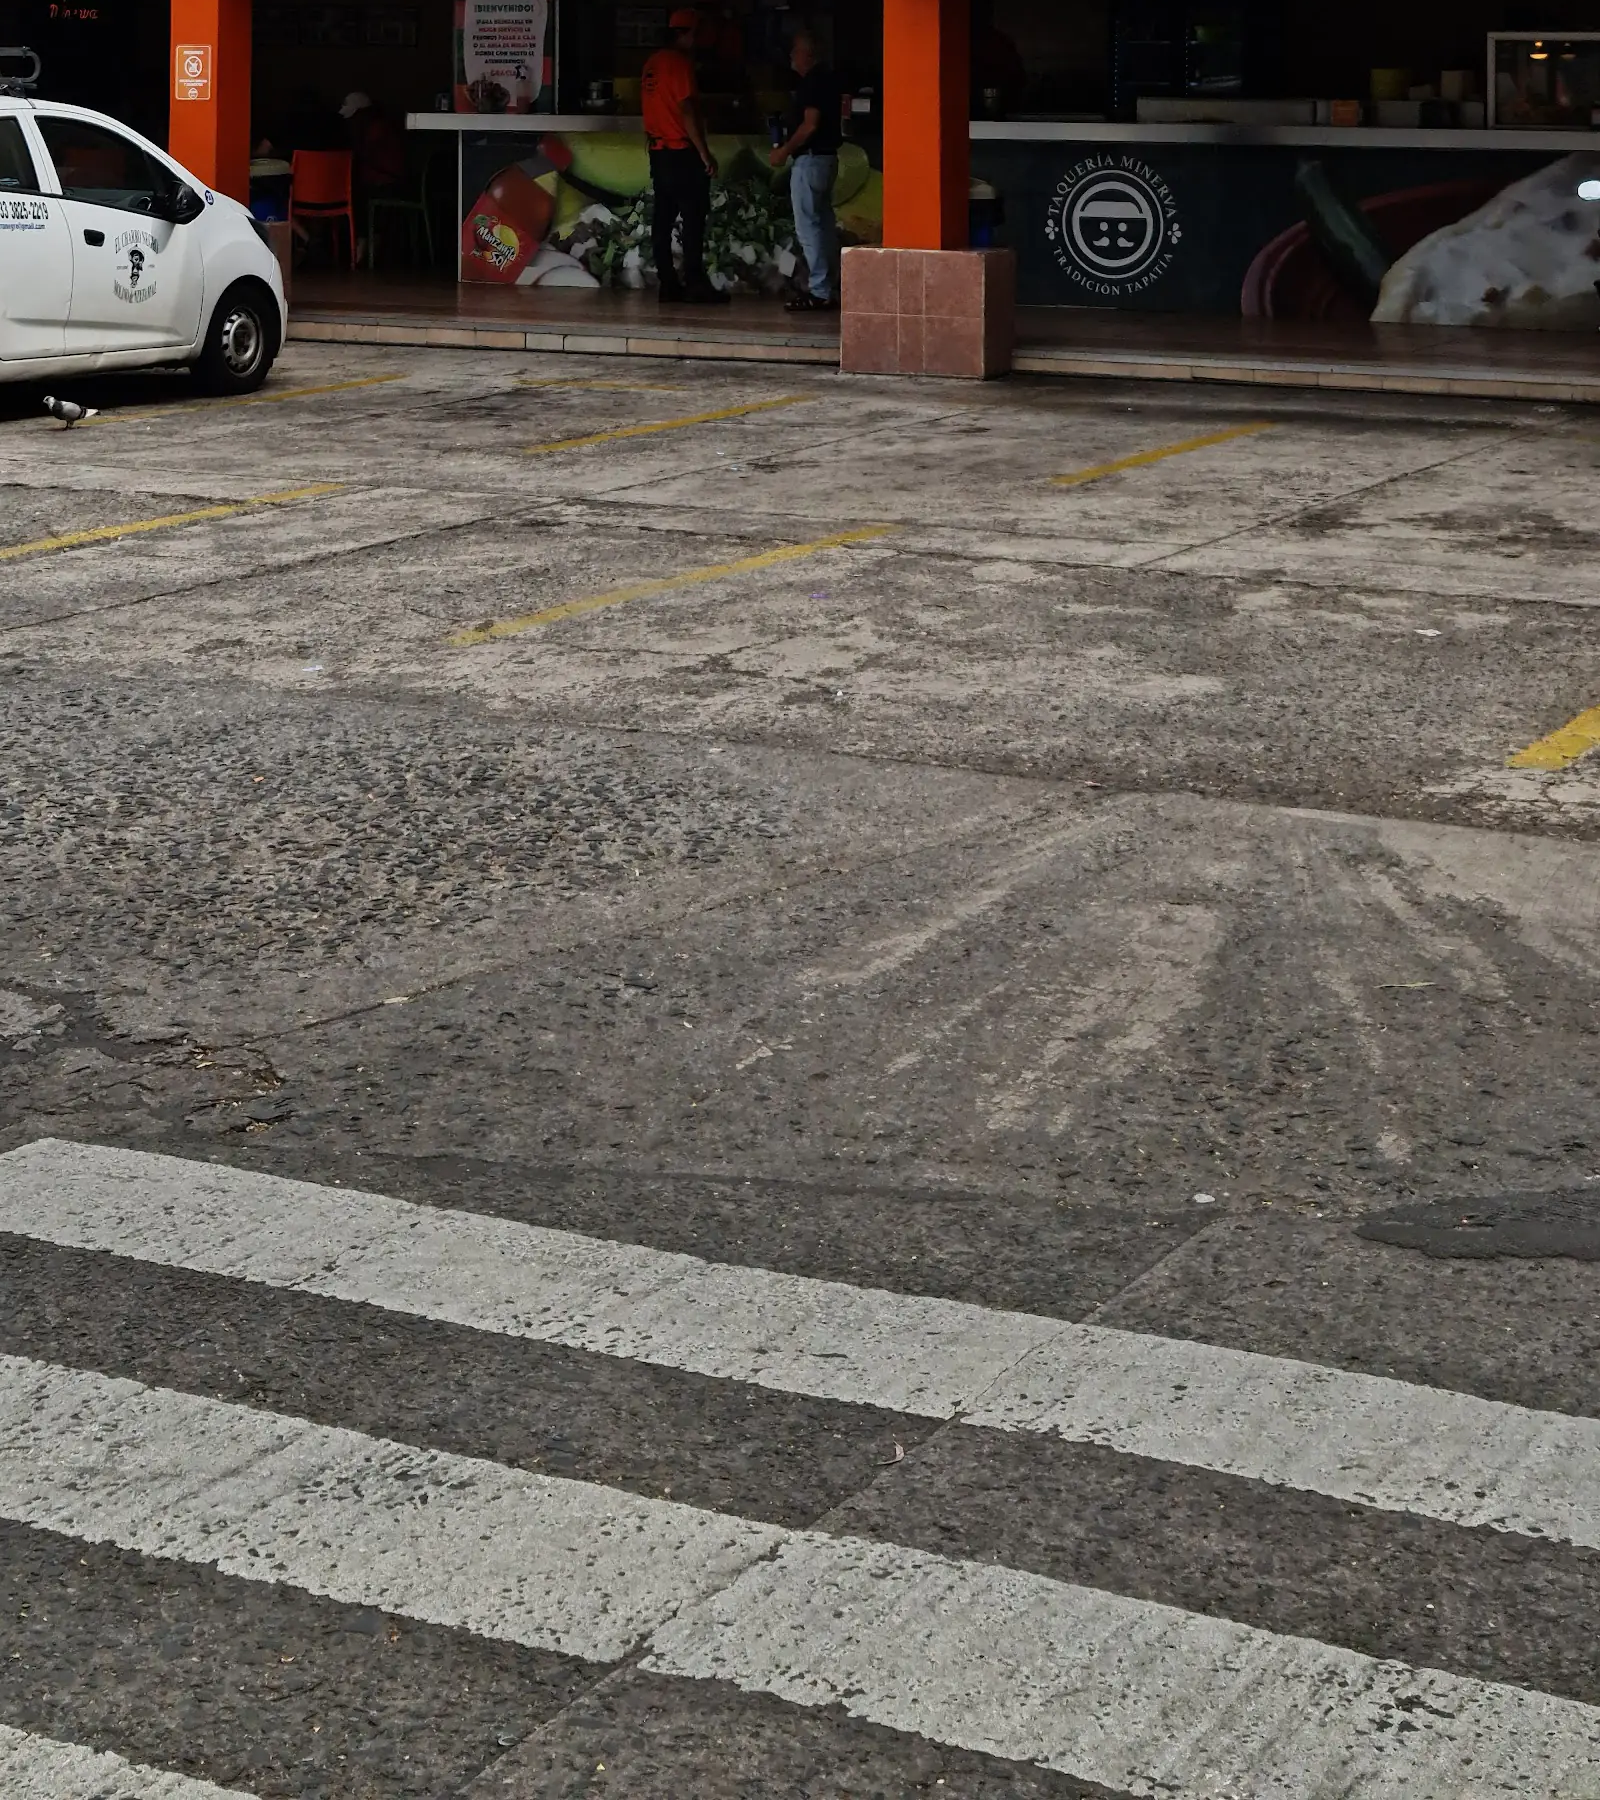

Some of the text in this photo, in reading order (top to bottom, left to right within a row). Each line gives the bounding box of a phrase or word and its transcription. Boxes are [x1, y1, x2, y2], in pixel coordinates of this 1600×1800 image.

[1047, 152, 1178, 219] TAQUERÍA MINERVA
[9, 201, 49, 220] 3825-2219
[476, 226, 517, 262] Manzanita
[1053, 245, 1174, 296] TRADICIÓN TAPATÍA
